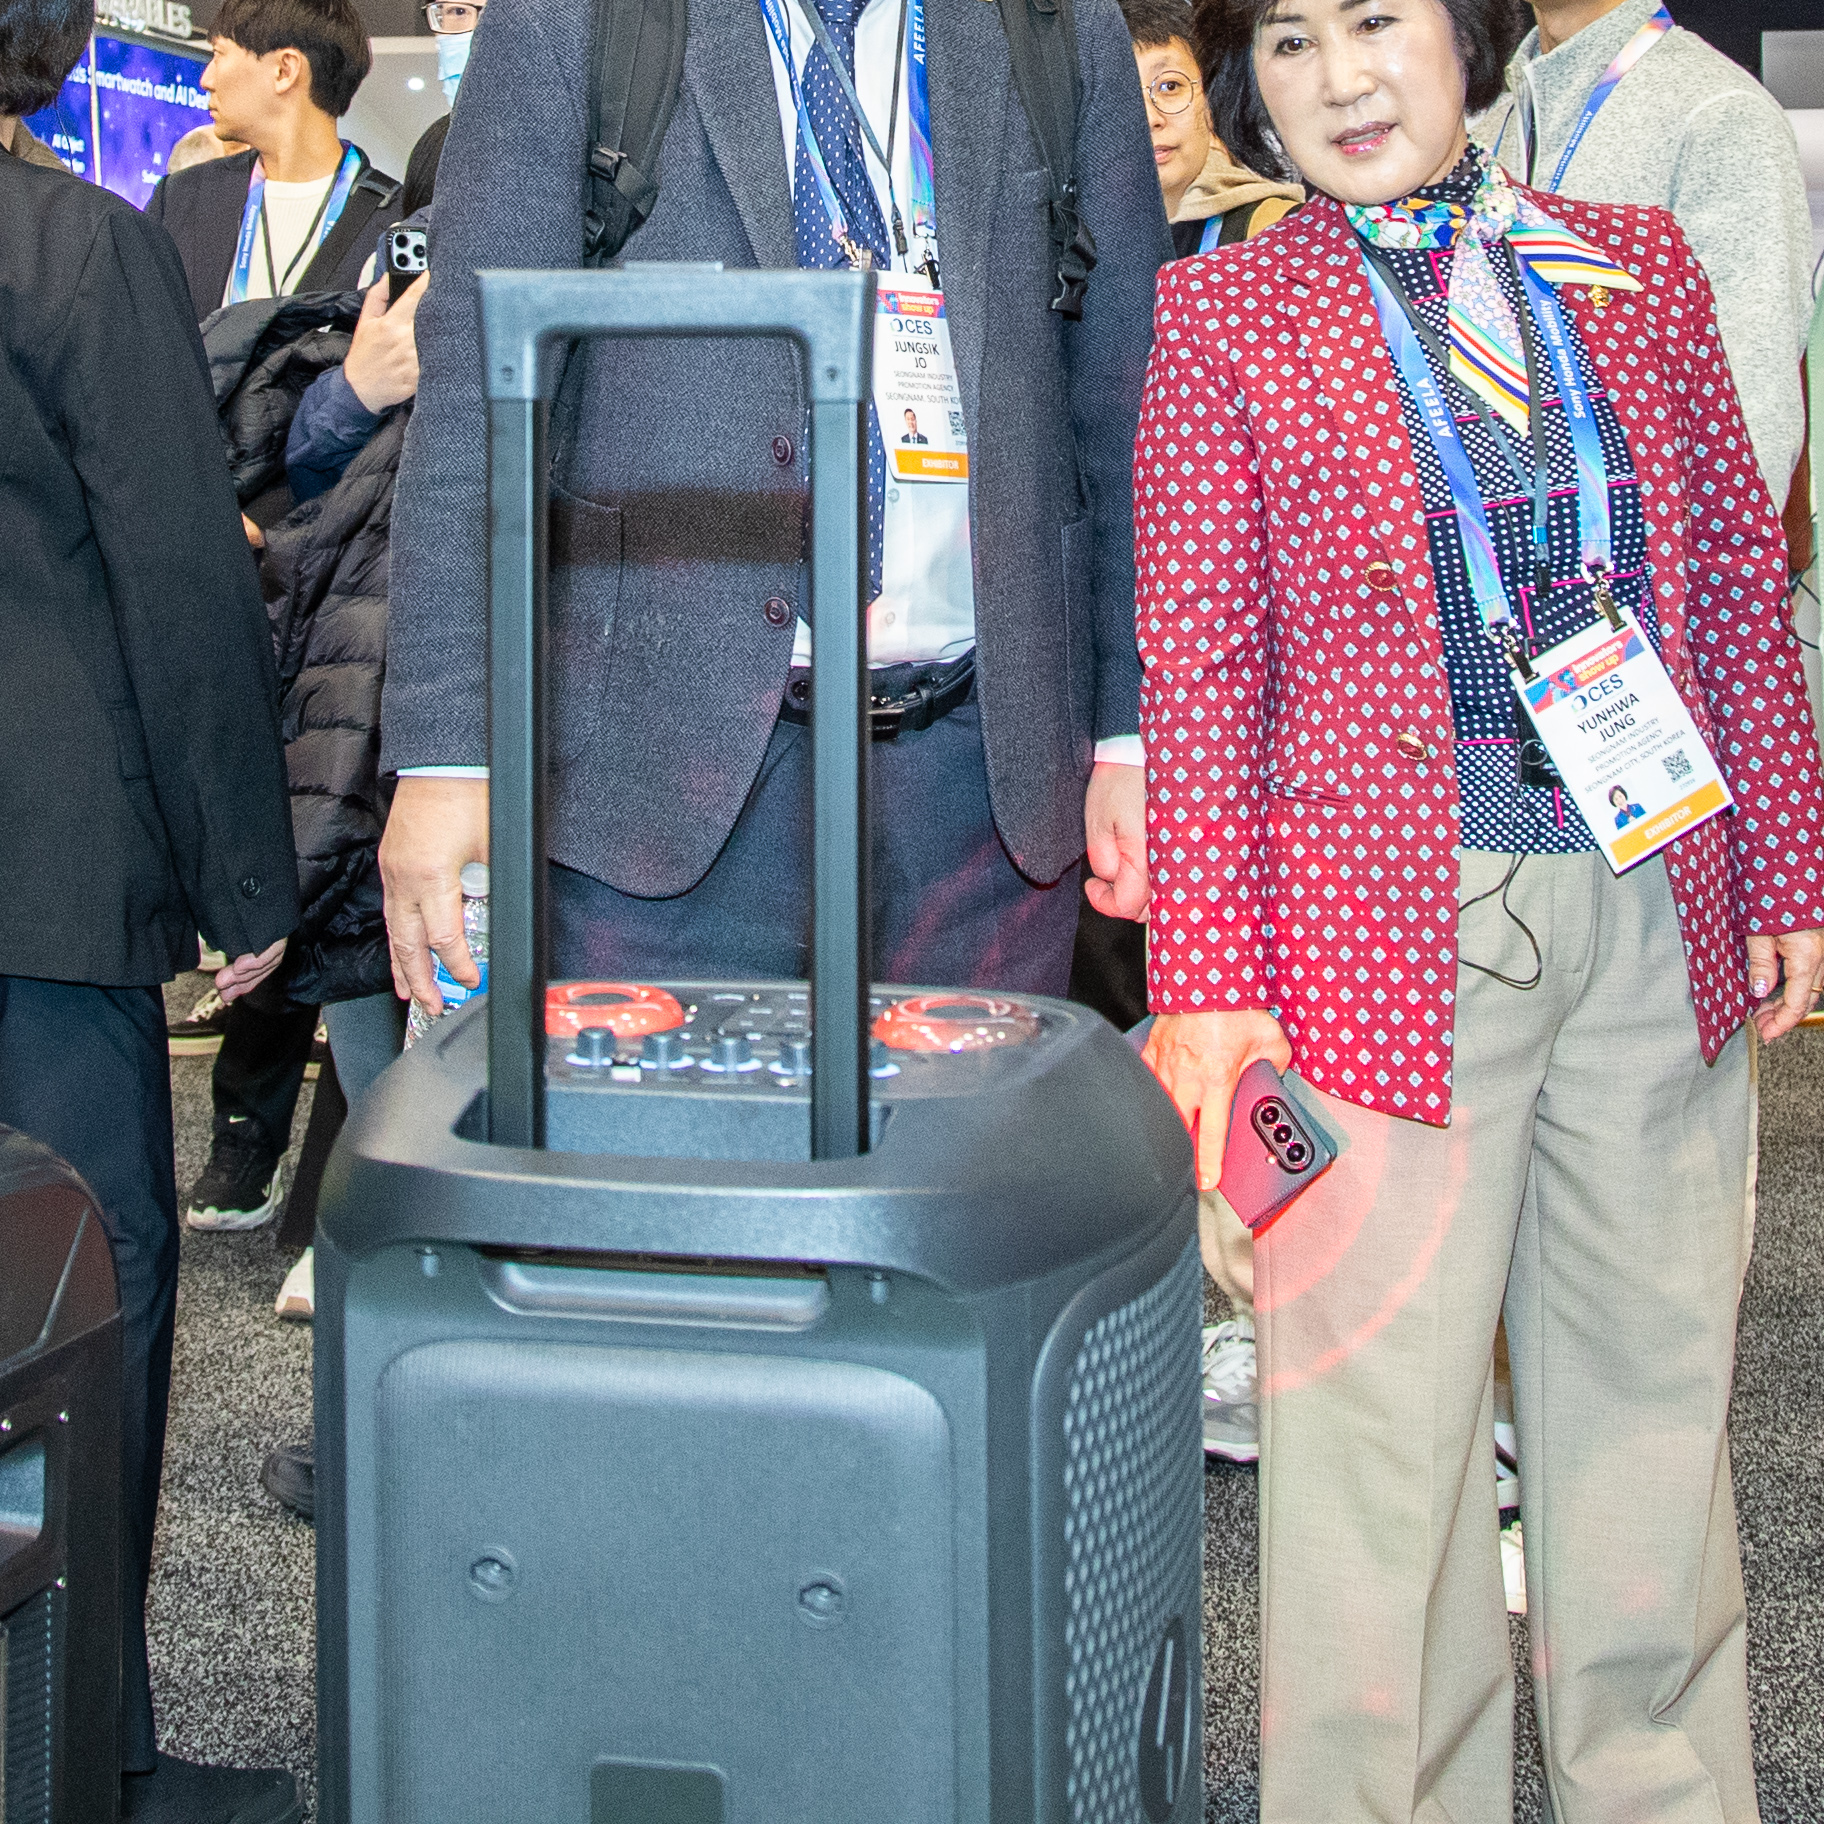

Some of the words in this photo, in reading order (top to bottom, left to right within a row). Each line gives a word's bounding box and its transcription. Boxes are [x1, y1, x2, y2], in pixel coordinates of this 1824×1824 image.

[912, 4, 925, 65] AFEELA
[154, 84, 176, 104] and
[905, 318, 934, 336] CES
[1539, 299, 1564, 347] Mobility
[894, 340, 941, 356] JUNGSIK
[914, 356, 928, 369] JO
[1556, 348, 1577, 388] Honda
[1416, 377, 1454, 439] AFEELA
[1568, 388, 1587, 420] Sony
[921, 458, 960, 471] EXHIBITOR
[1578, 661, 1606, 682] show
[1604, 654, 1620, 667] up
[1588, 673, 1624, 702] CES
[1577, 693, 1640, 734] YUNHWA
[1600, 713, 1636, 742] JUNG
[1587, 736, 1627, 764] SEONGNAM
[1627, 716, 1661, 742] INDUSTRY
[1595, 744, 1638, 773] PROMOTION
[1636, 728, 1664, 751] AGENCY
[1584, 767, 1624, 794] SEONGNAM
[1639, 742, 1664, 761] SOUTH
[1663, 729, 1687, 748] KOREA
[1643, 805, 1693, 841] EXHIBITOR
